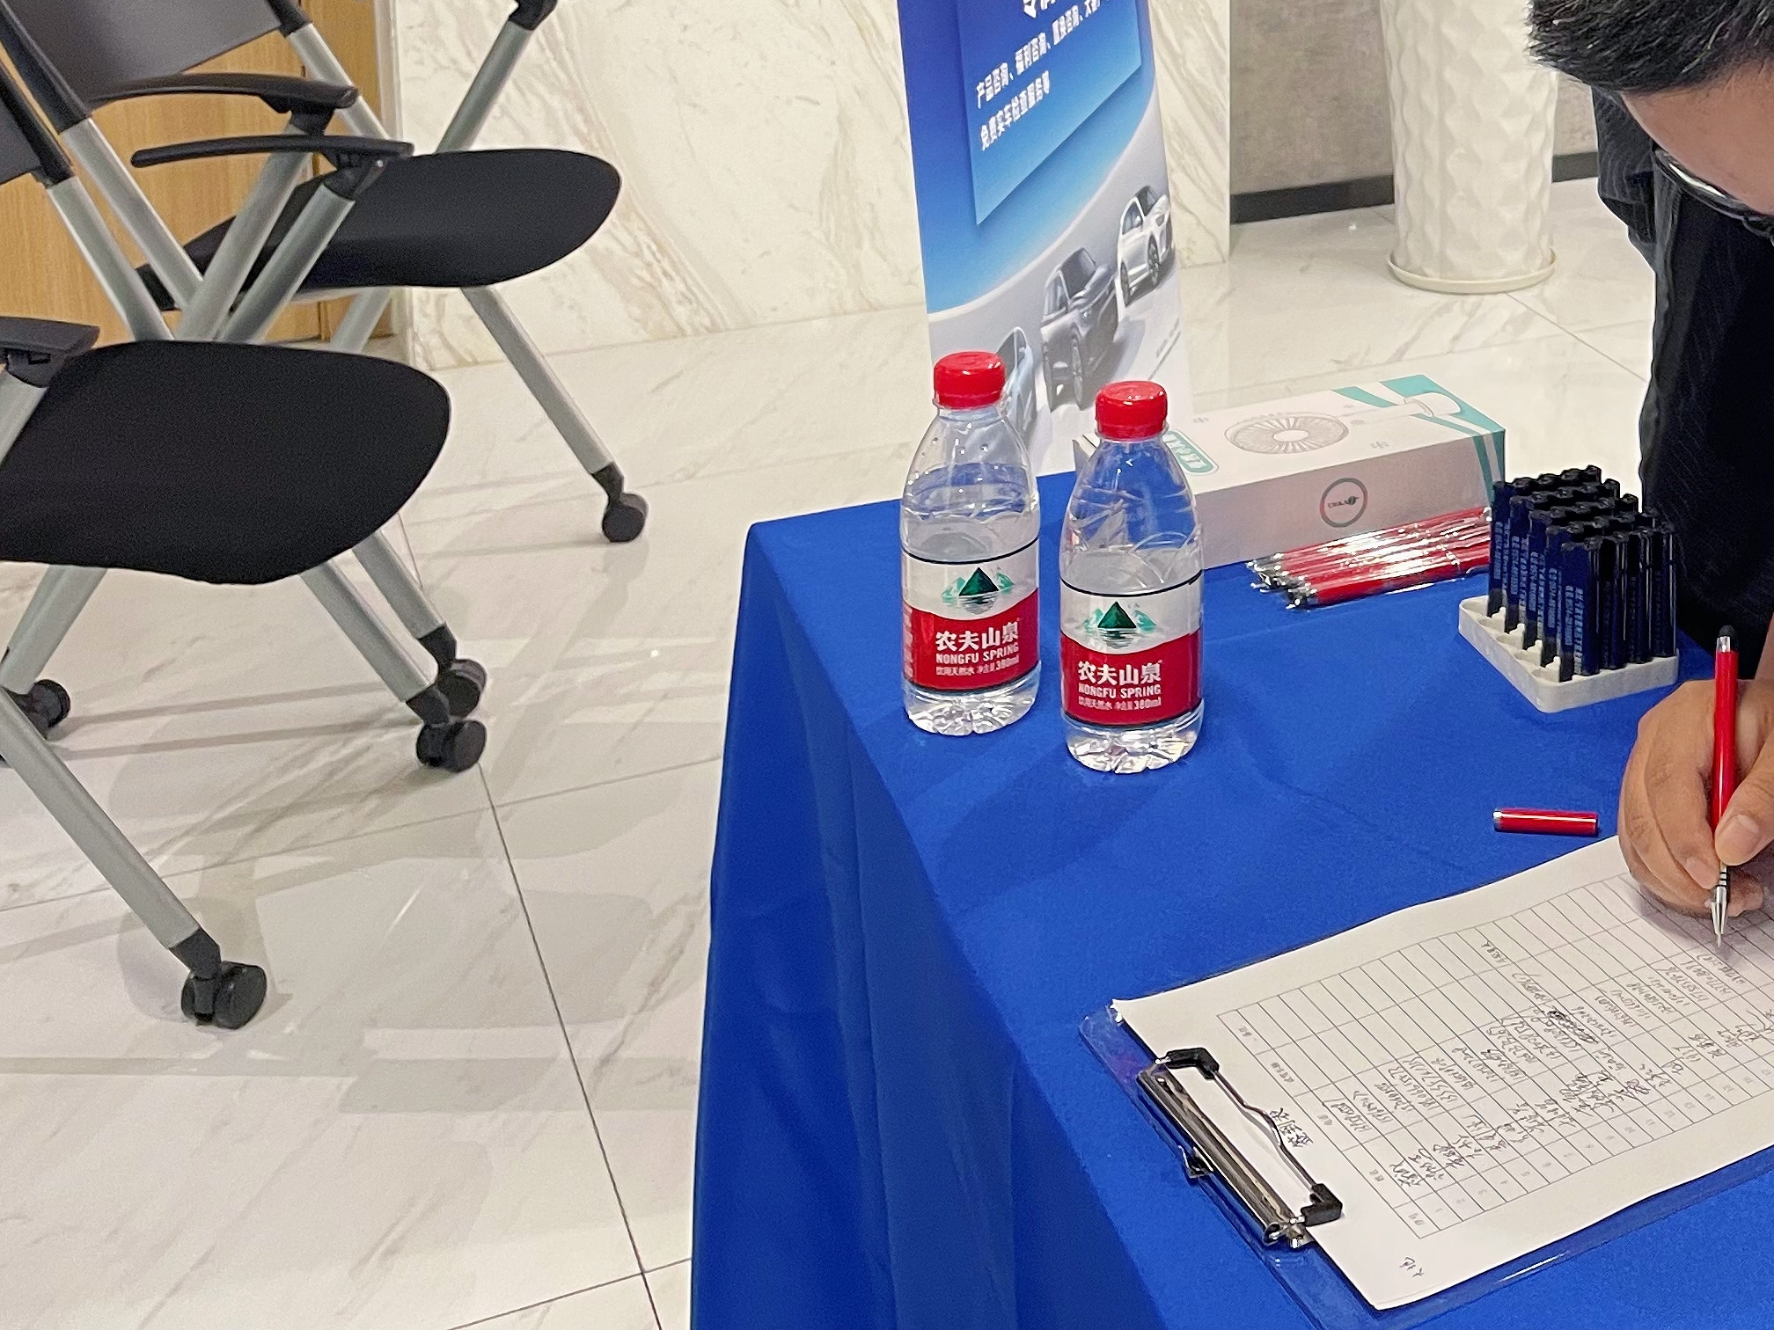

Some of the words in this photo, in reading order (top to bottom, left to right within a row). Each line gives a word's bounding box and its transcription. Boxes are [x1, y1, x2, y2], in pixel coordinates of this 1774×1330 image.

[935, 621, 1019, 652] 农夫山泉
[936, 652, 979, 665] NONGFU
[982, 642, 1019, 662] SPRING
[1078, 660, 1162, 686] 农夫山泉
[1078, 682, 1117, 699] NONGFU
[1120, 684, 1162, 699] SPRING
[1269, 1107, 1314, 1148] 签到表
